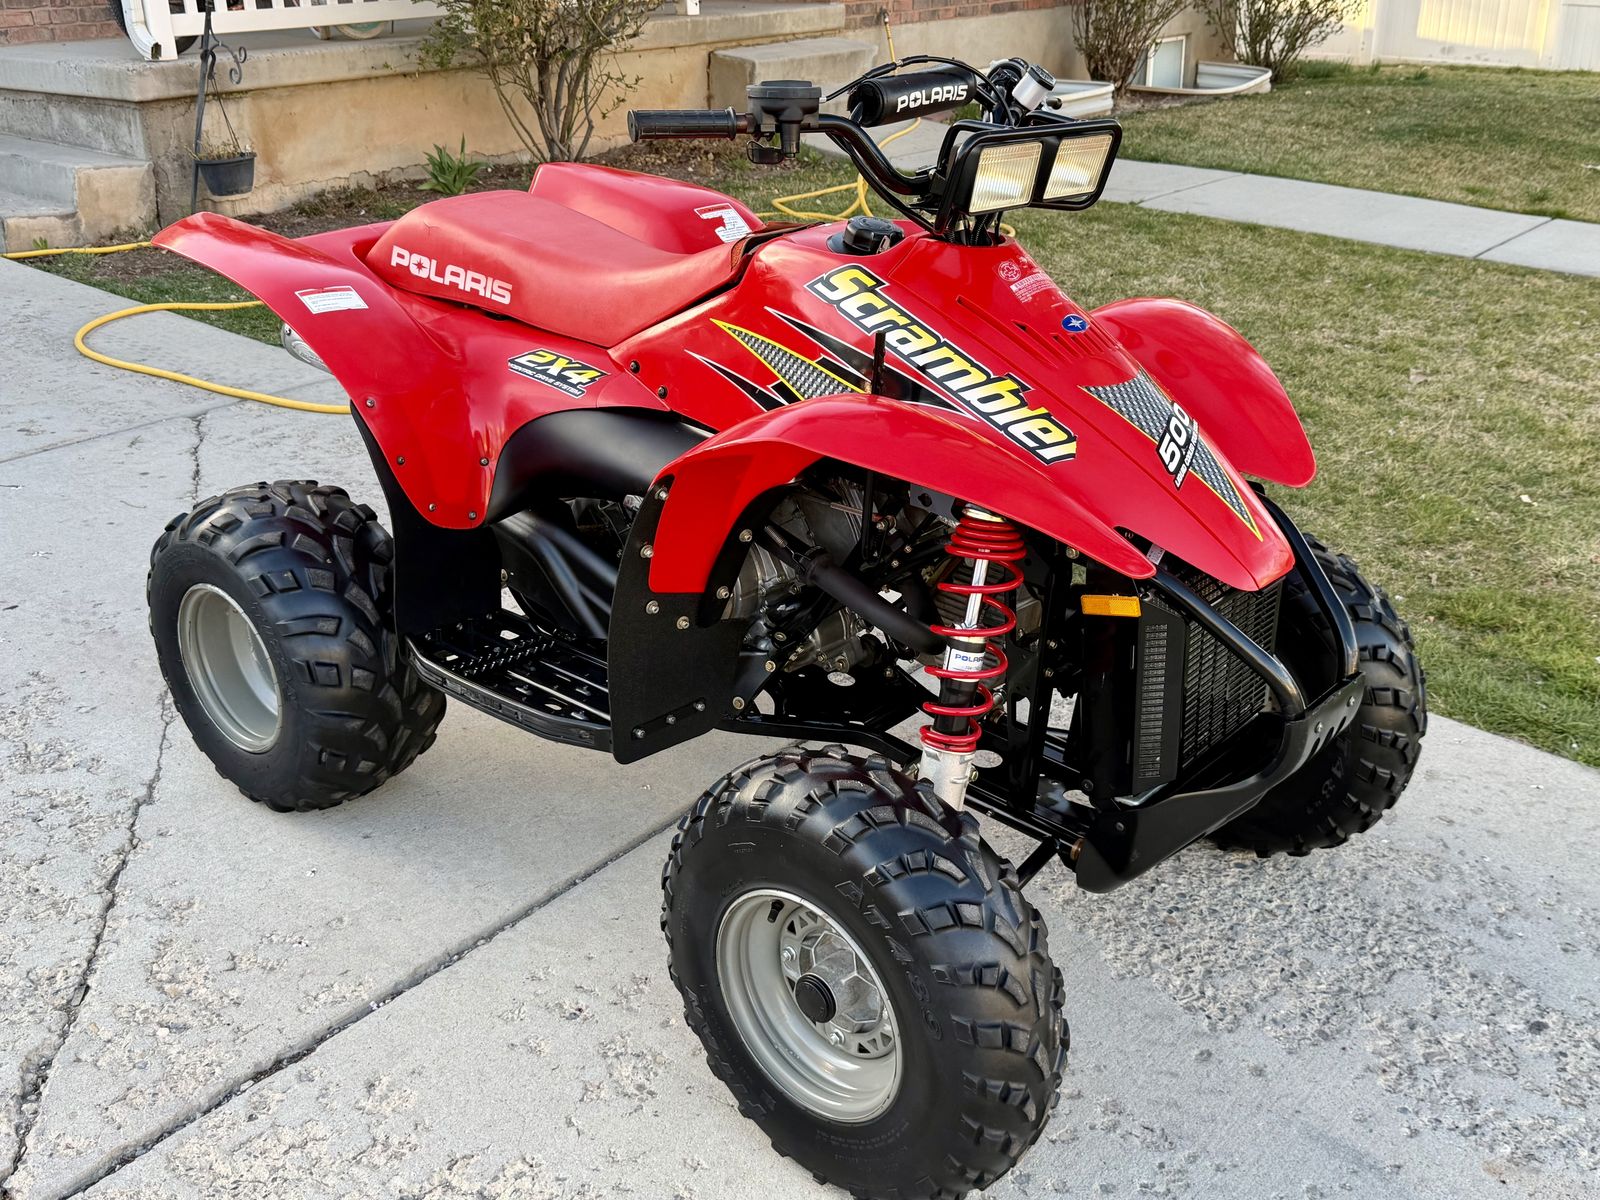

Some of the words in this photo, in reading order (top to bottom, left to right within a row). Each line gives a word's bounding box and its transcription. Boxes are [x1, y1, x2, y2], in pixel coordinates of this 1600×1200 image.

[896, 84, 968, 113] POLARIS
[390, 244, 513, 305] POLARIS
[513, 350, 601, 385] 2X4
[810, 266, 1077, 463] Scrambler
[1158, 402, 1190, 473] 500
